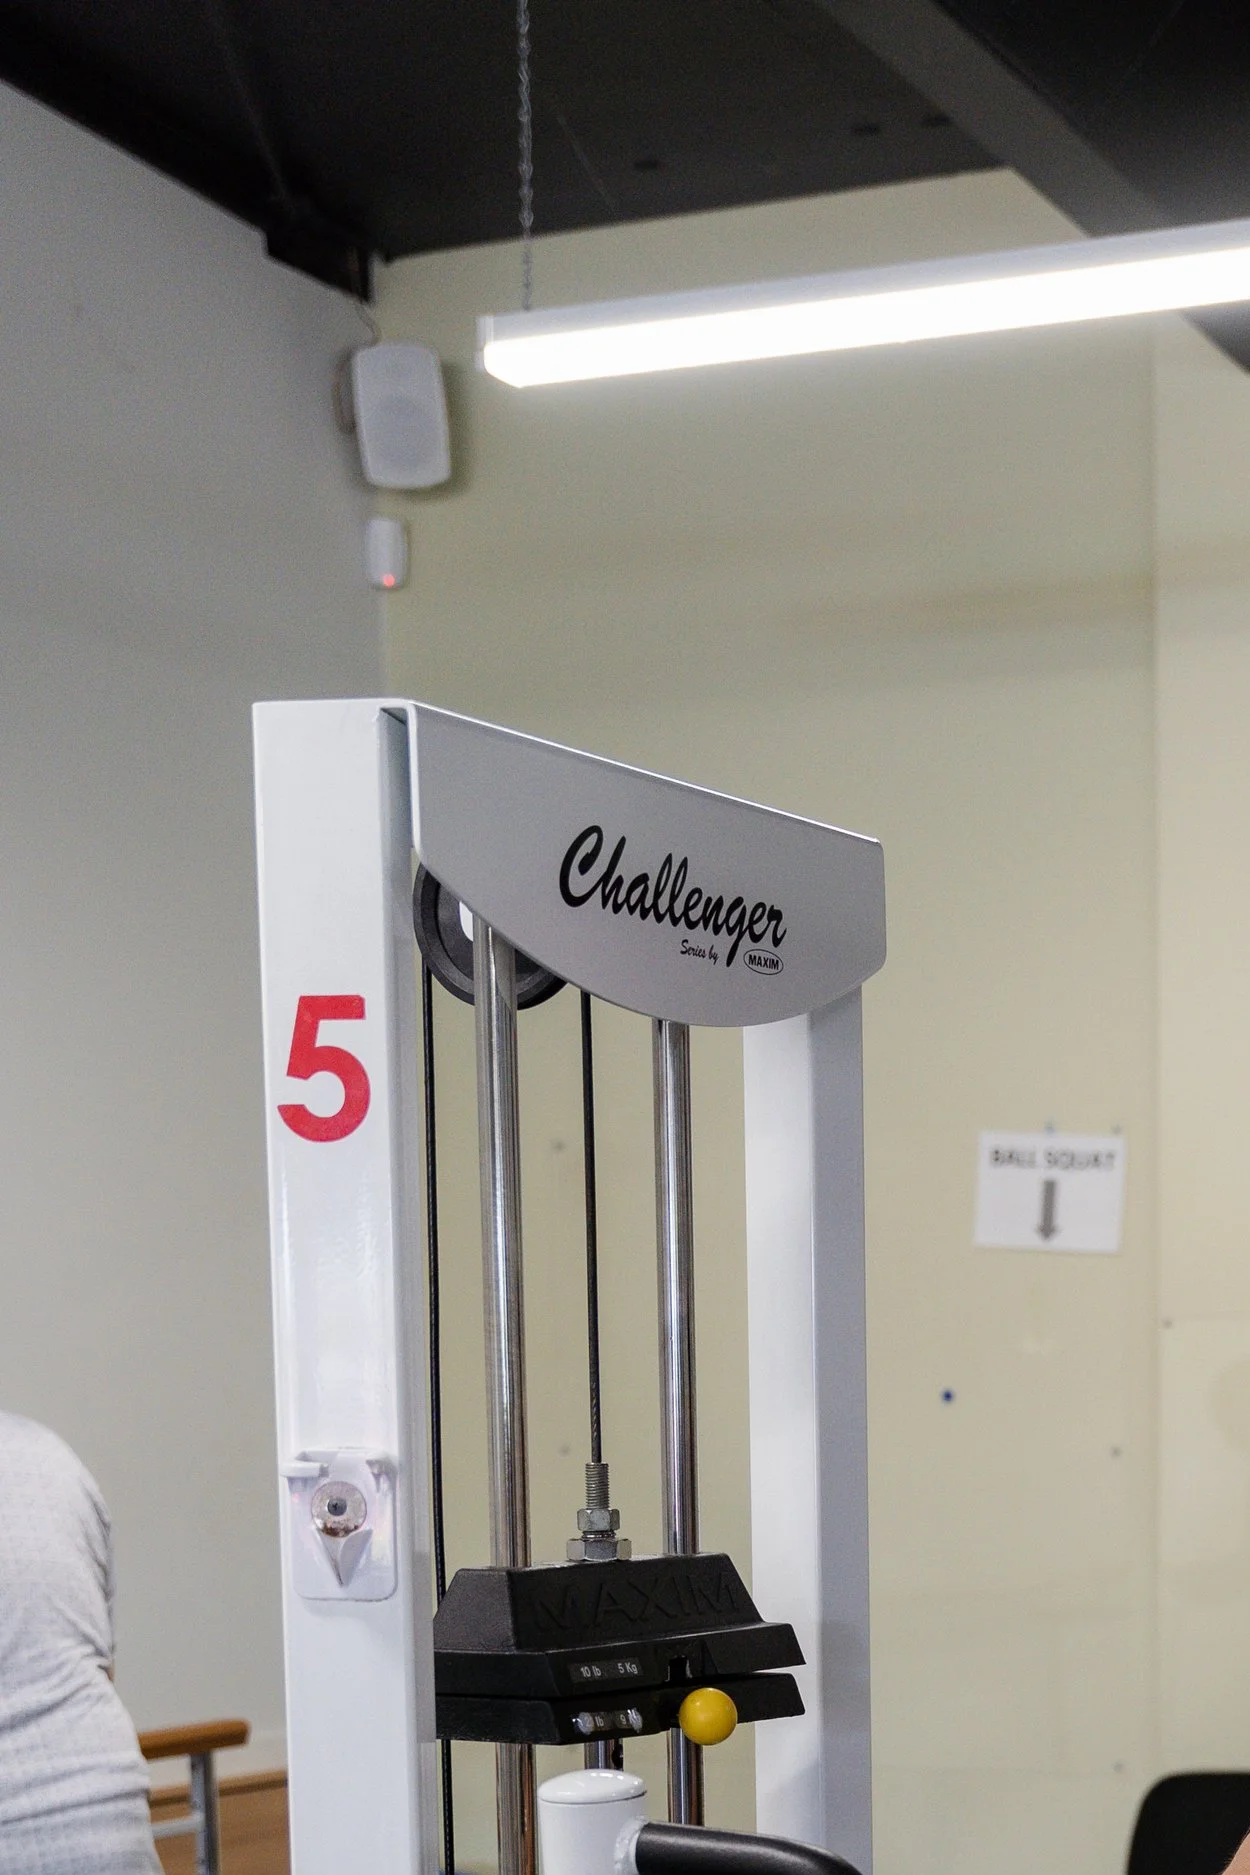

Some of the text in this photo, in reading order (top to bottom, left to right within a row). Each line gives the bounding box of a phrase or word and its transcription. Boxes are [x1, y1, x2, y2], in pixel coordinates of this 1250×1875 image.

[559, 825, 787, 967] Challenger
[680, 939, 779, 970] Series by MAXIM
[277, 995, 371, 1142] 5
[532, 1574, 738, 1630] MAXIM
[580, 1662, 638, 1677] 10 lb 5 Kg
